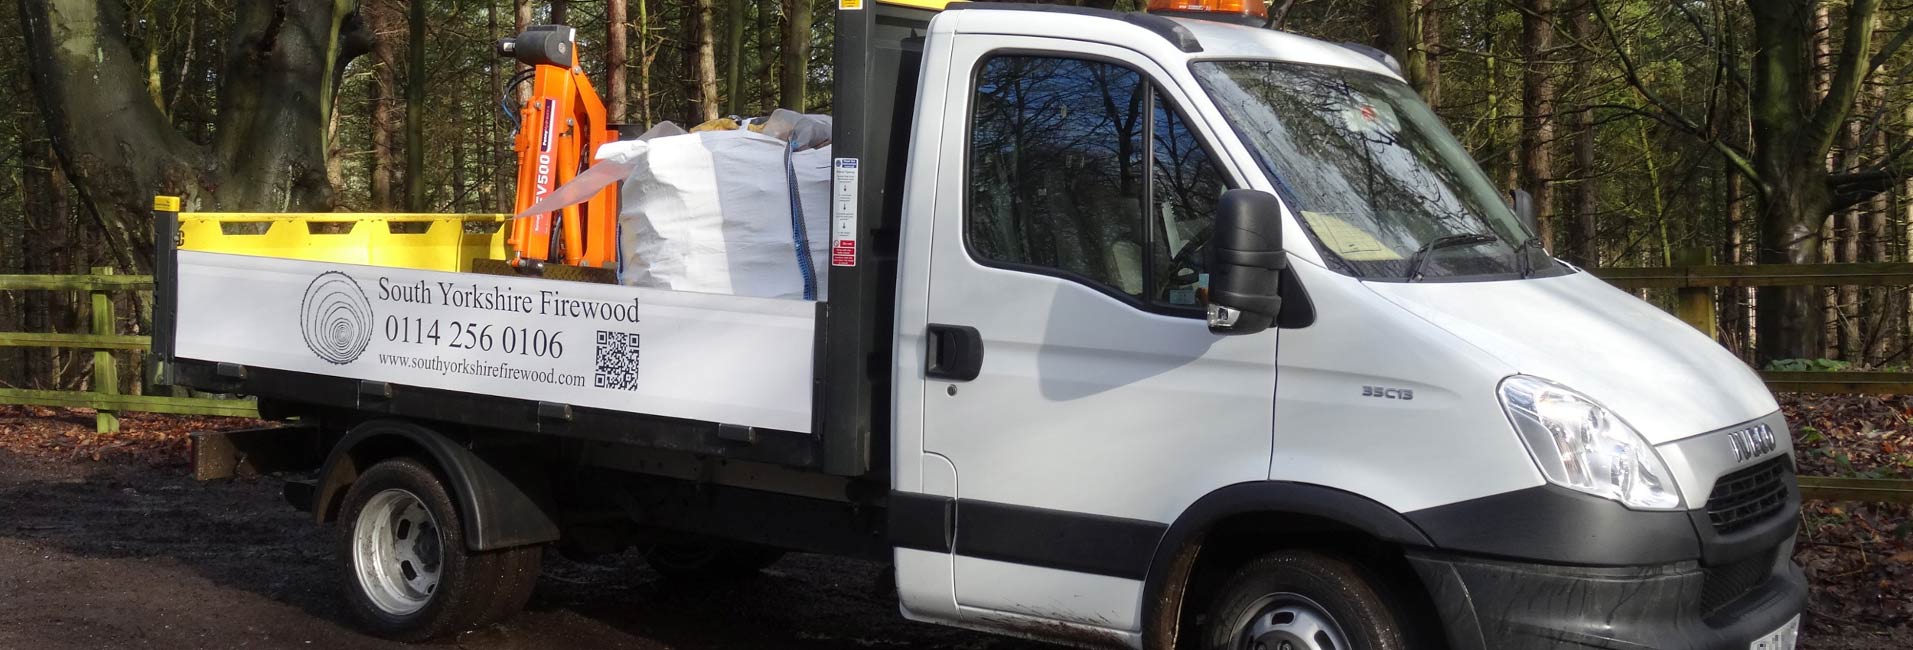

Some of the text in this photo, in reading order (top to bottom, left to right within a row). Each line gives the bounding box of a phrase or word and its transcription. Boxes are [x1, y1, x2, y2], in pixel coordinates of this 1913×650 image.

[378, 276, 640, 323] South Yorkshire Firewood
[385, 314, 564, 359] 0114 256 0106
[379, 352, 586, 387] www.southyorkshirefirewood.com
[1361, 385, 1414, 401] 35C13
[1727, 422, 1777, 463] IVECO
